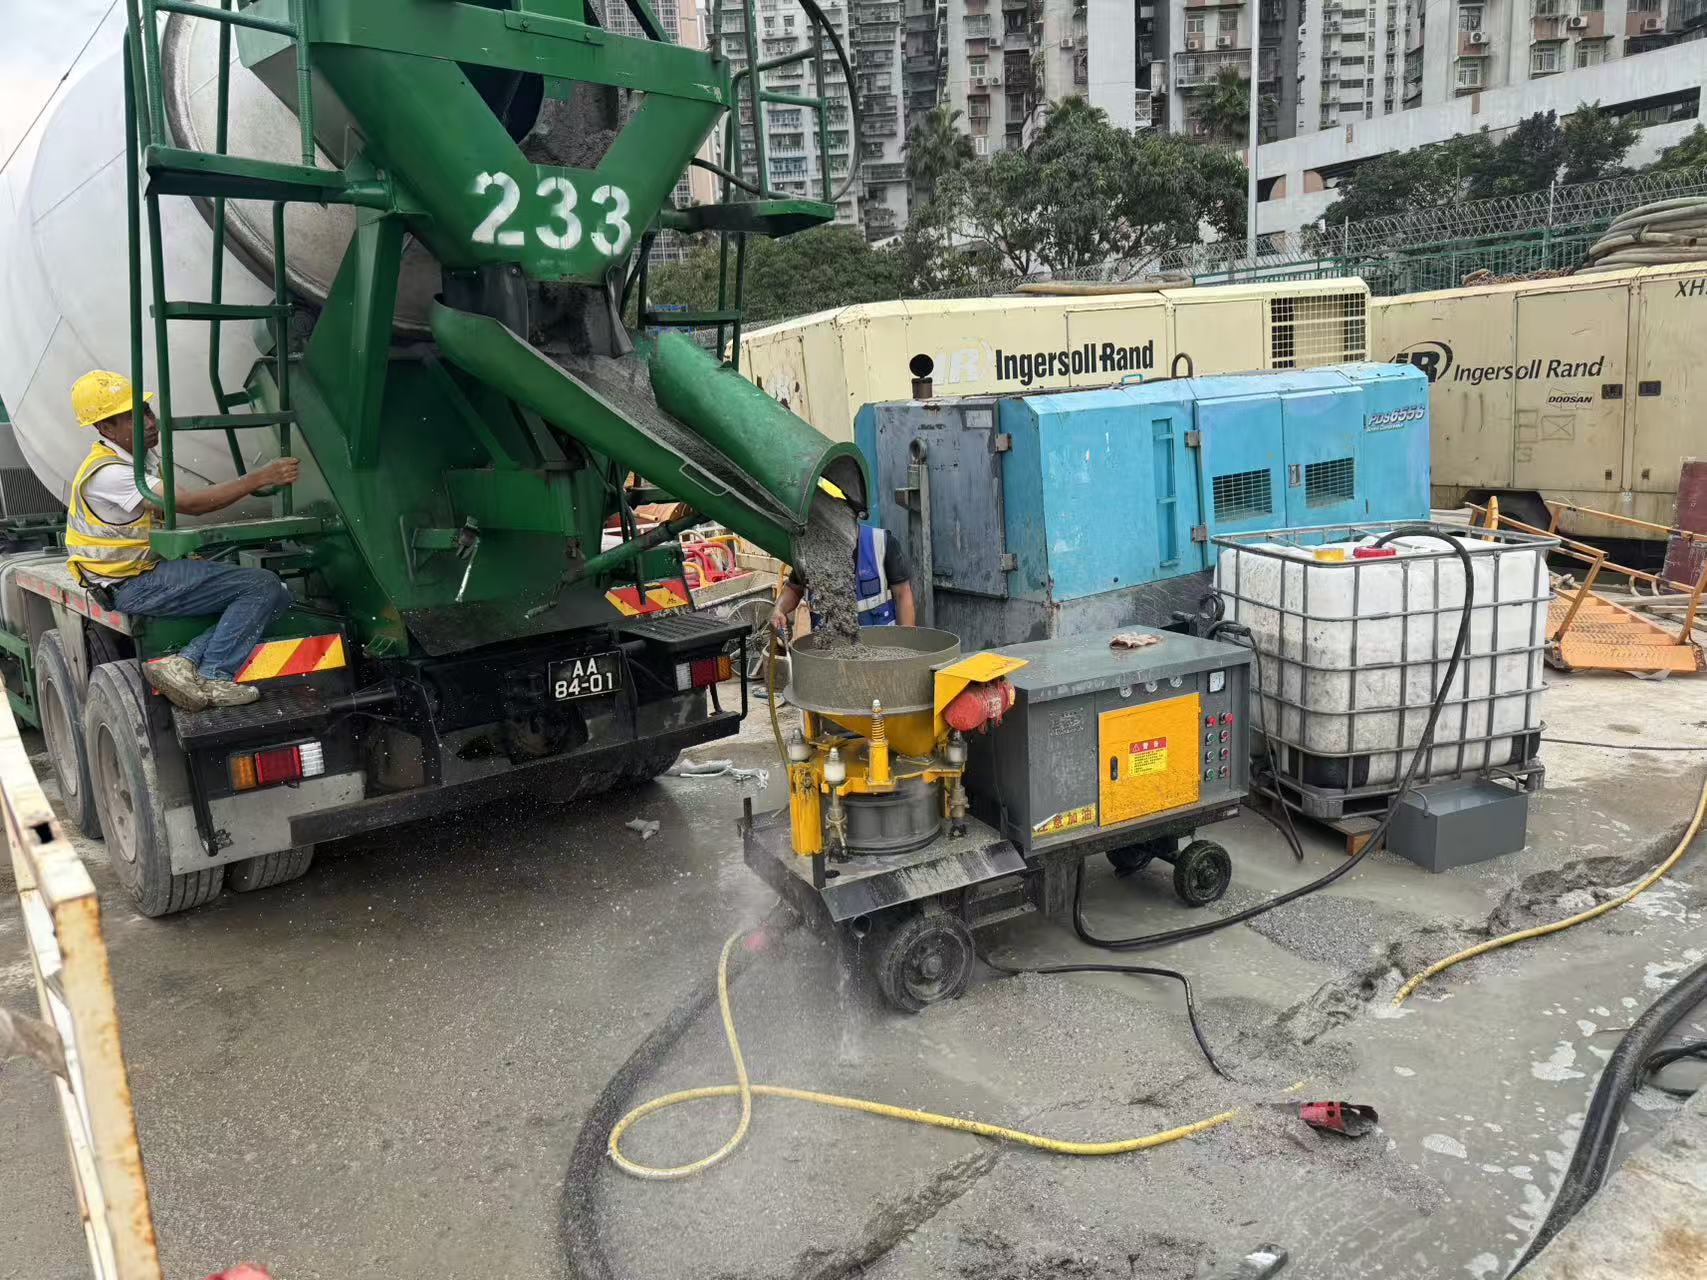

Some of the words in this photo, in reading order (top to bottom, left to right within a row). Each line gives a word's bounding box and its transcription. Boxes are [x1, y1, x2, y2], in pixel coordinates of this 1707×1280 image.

[471, 171, 632, 256] 233
[1674, 279, 1707, 298] XH
[1453, 358, 1542, 386] Ingersoll
[1546, 355, 1605, 379] Rand
[1548, 395, 1593, 403] DOOSAN
[572, 657, 598, 678] AA
[555, 672, 613, 698] 84-01
